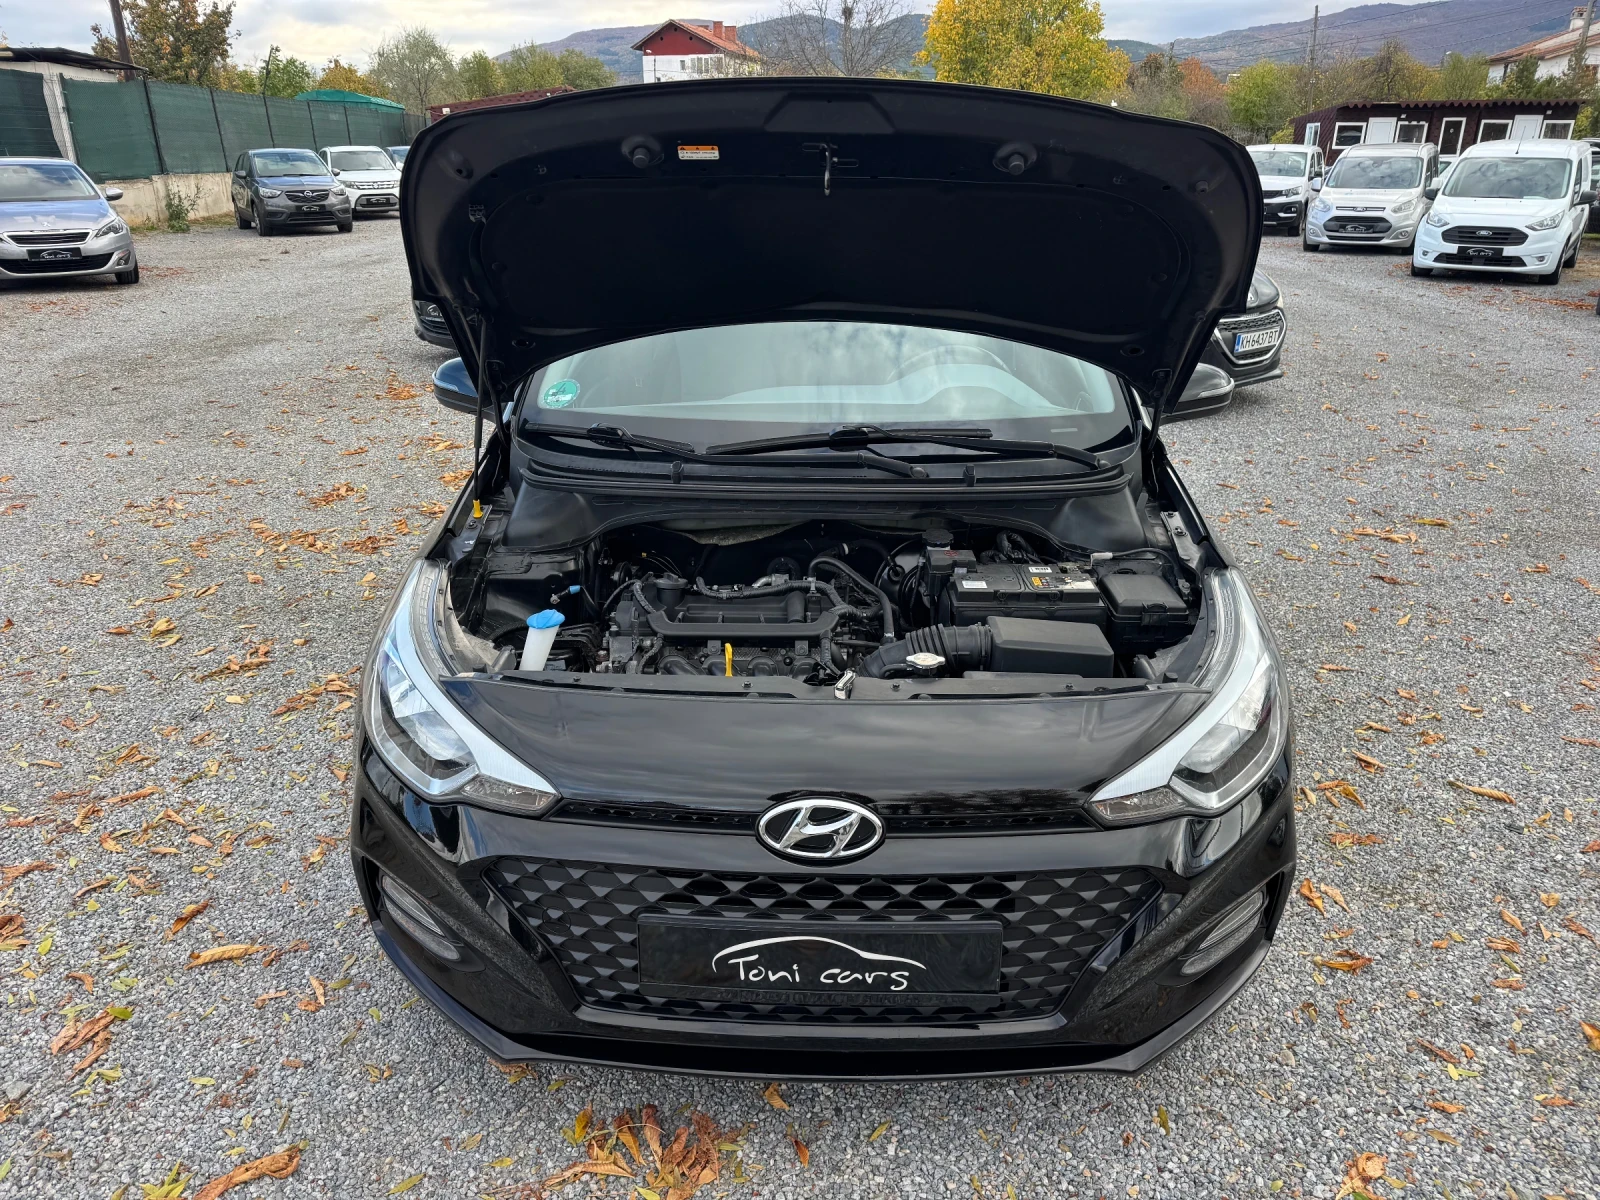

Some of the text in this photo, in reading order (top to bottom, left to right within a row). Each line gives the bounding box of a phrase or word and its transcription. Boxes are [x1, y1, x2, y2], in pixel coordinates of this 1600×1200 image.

[1241, 330, 1278, 349] KH6437BT
[727, 954, 910, 991] Toni cars
